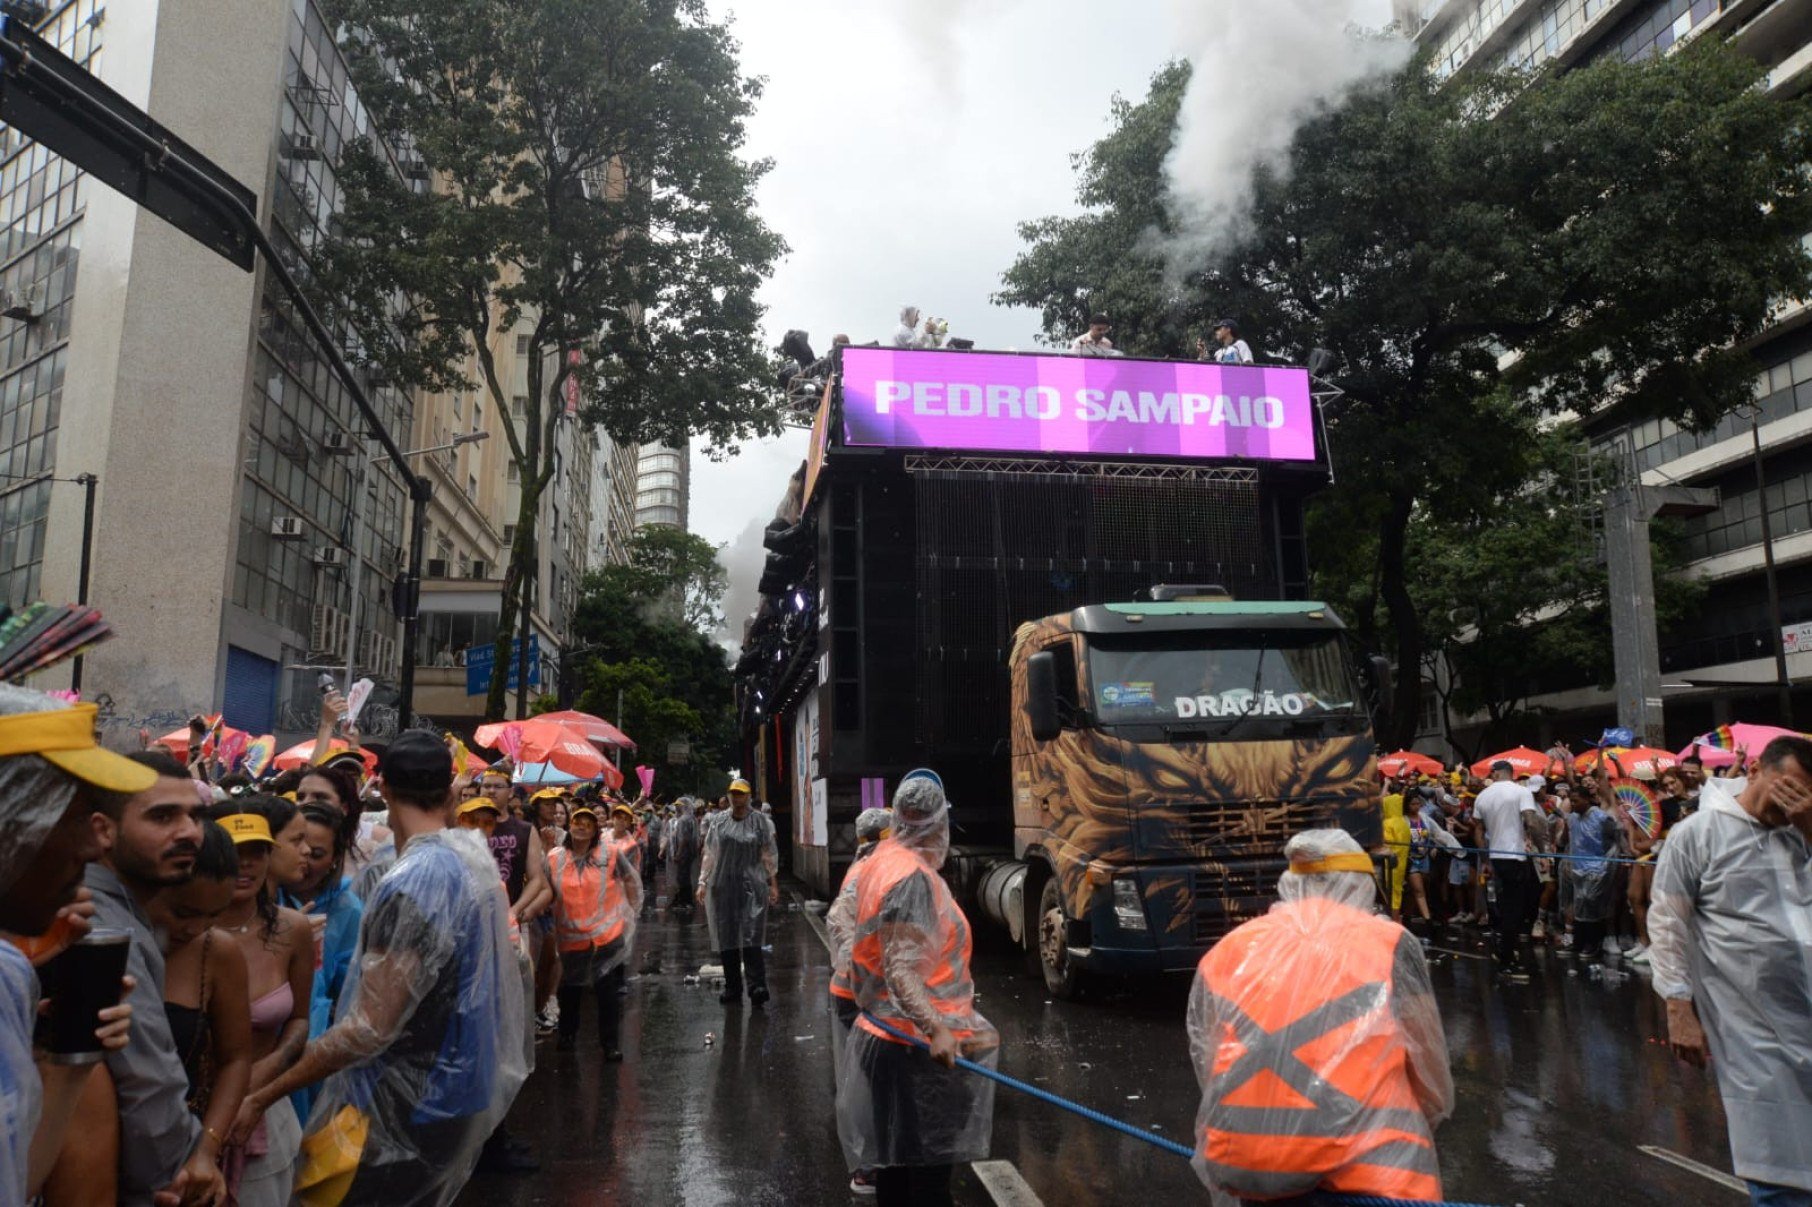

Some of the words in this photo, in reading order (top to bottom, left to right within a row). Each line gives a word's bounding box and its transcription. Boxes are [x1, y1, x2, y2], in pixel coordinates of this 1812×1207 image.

[875, 380, 1061, 420] PEDRO
[1076, 388, 1285, 429] SAMPAIO
[1175, 690, 1304, 718] DRAGÃO
